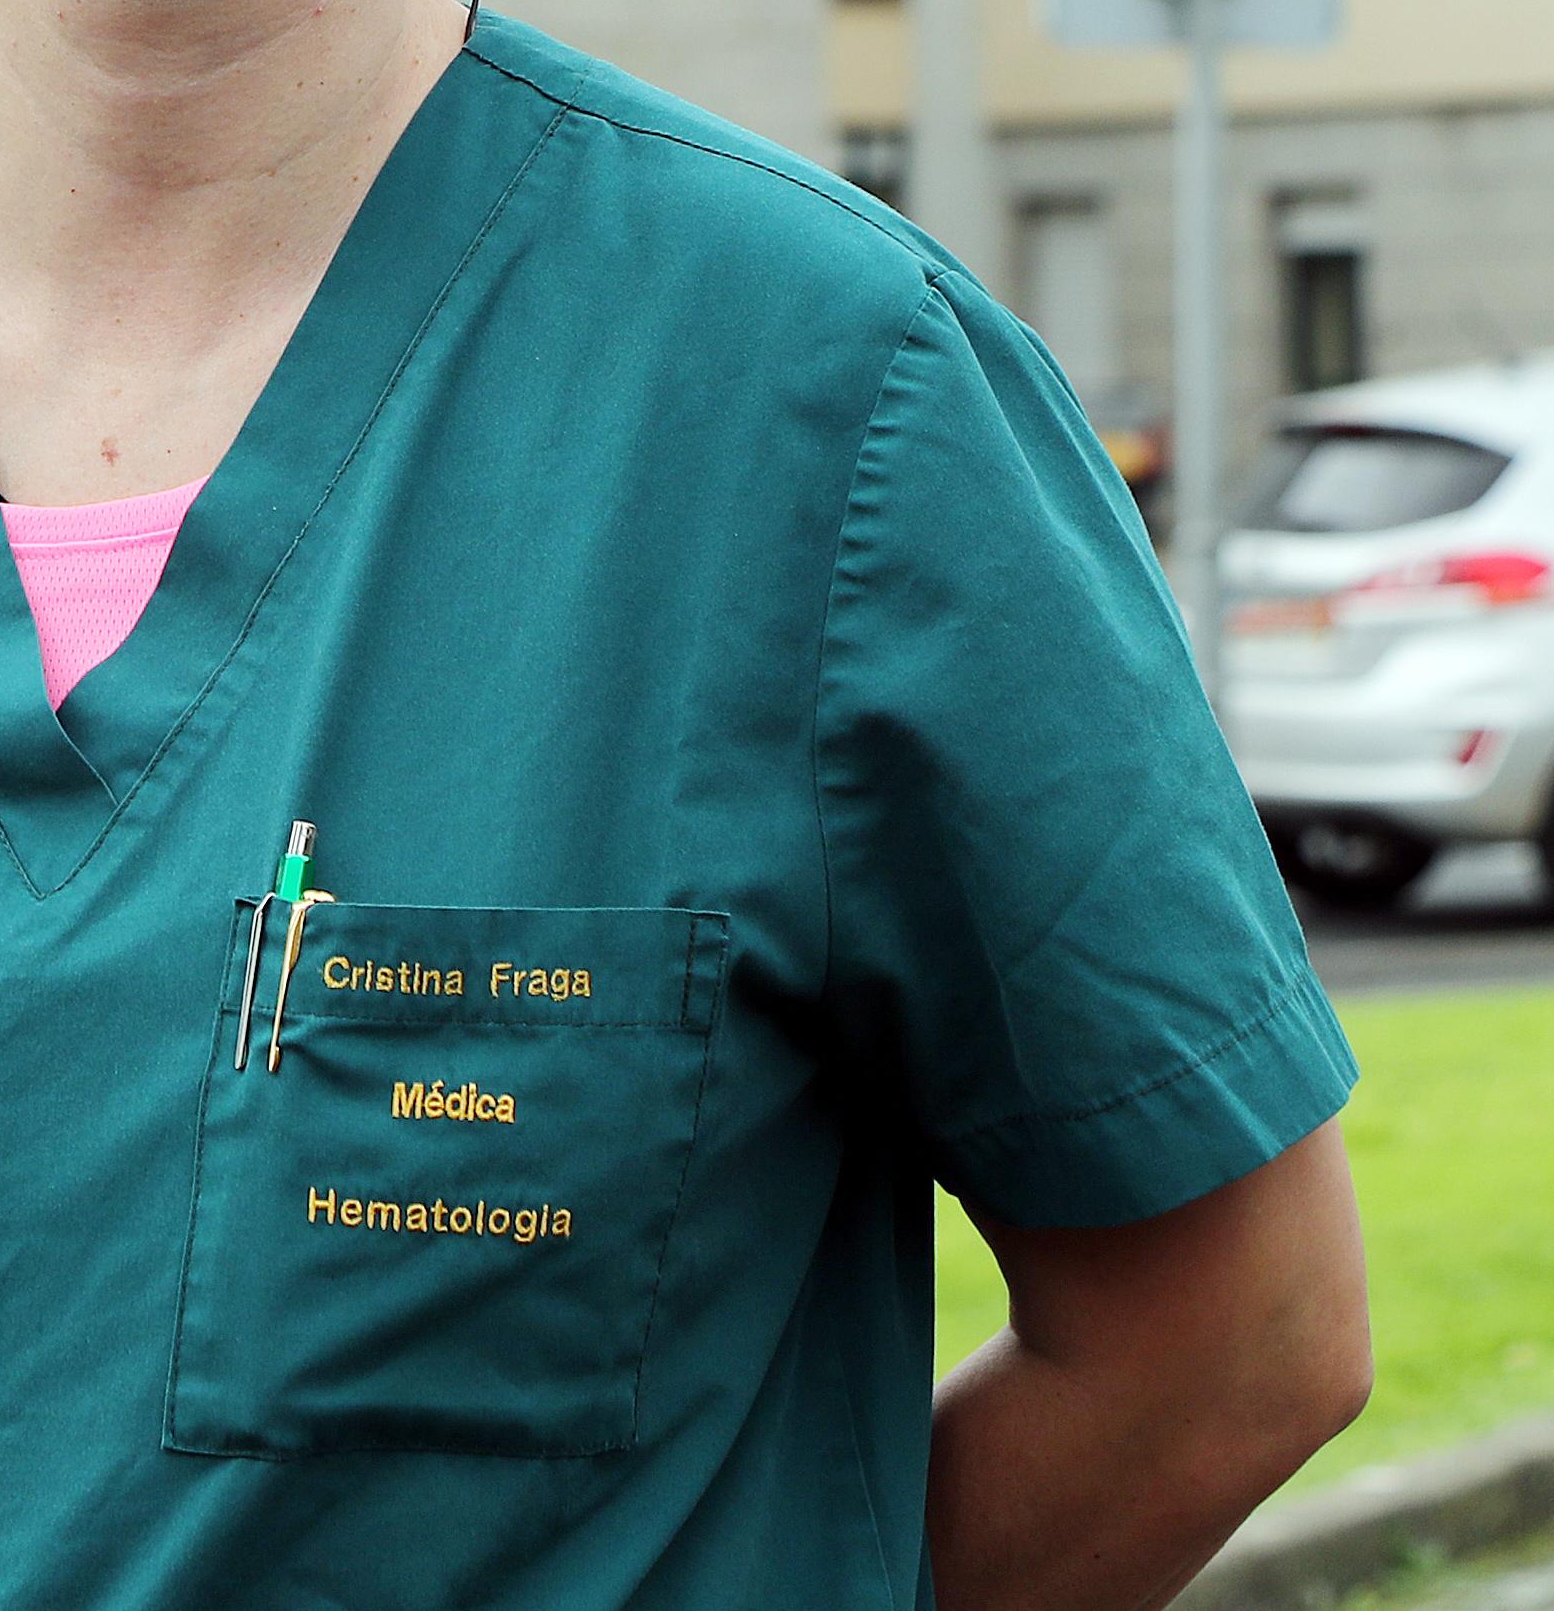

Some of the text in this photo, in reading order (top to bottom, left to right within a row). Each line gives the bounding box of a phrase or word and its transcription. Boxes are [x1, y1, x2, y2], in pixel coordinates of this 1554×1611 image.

[322, 956, 591, 1001] Cristina Fraga
[391, 1080, 516, 1124] Médica
[307, 1186, 573, 1244] Hematologia
